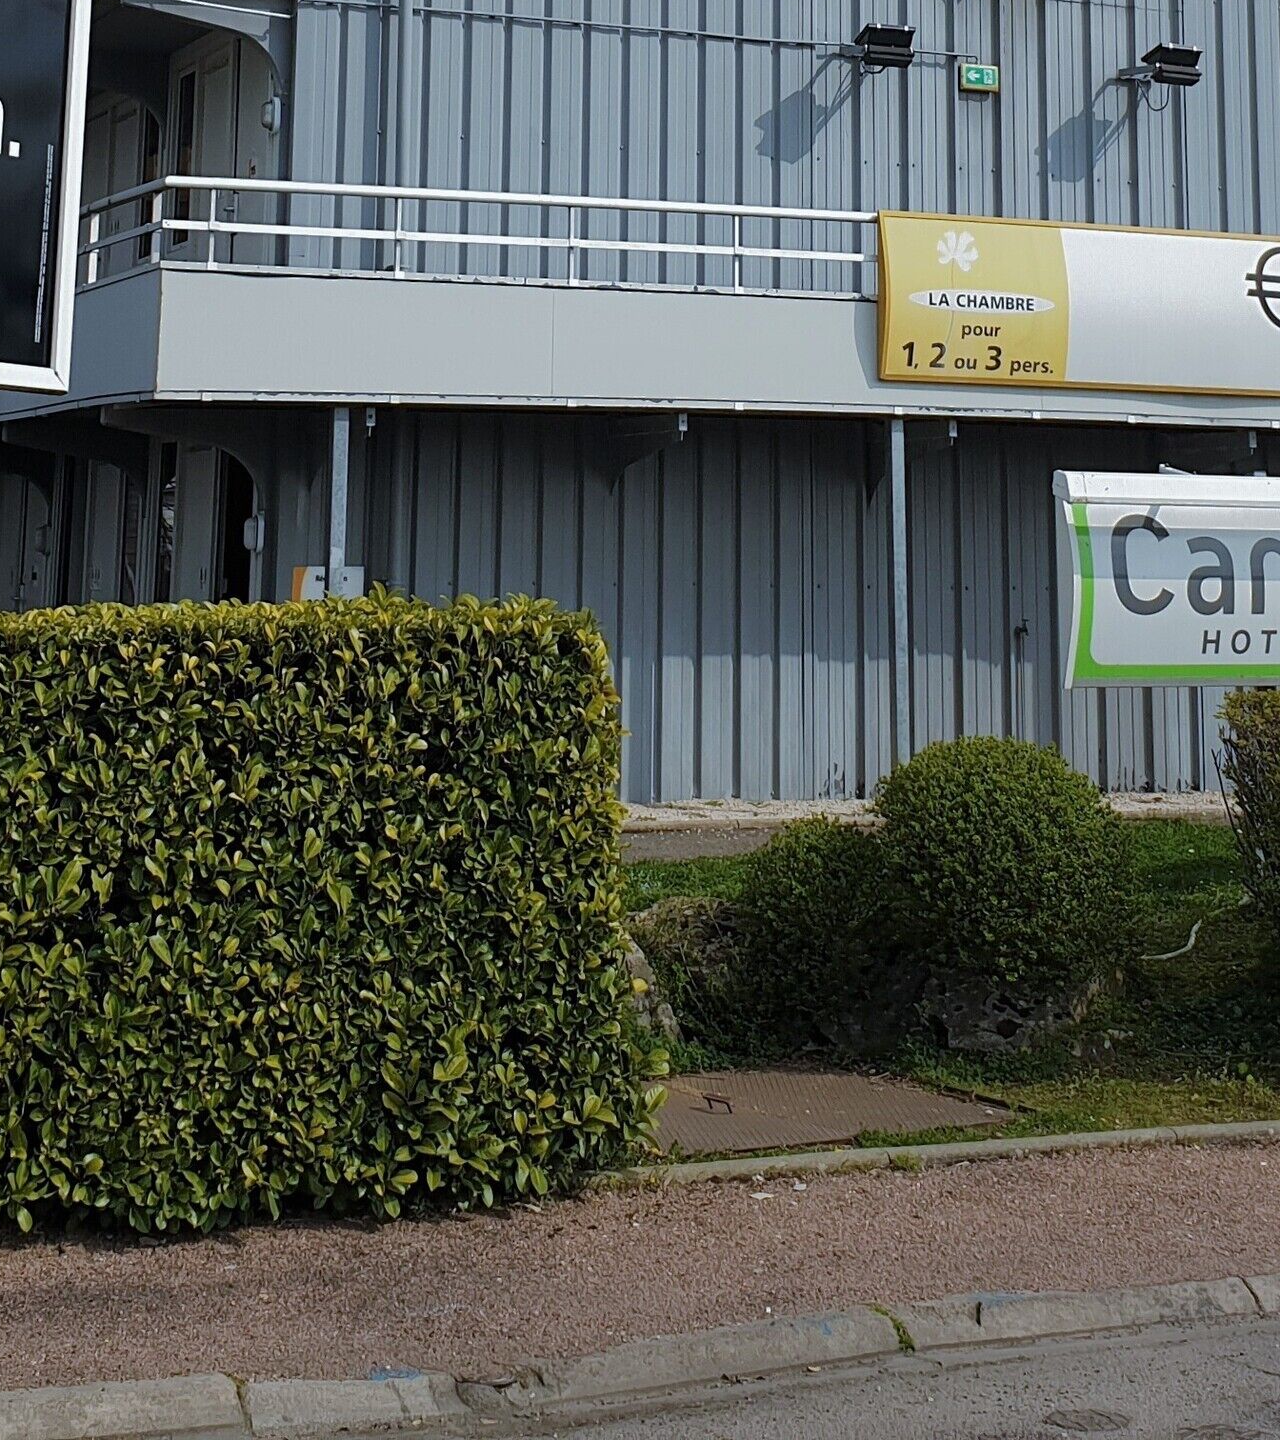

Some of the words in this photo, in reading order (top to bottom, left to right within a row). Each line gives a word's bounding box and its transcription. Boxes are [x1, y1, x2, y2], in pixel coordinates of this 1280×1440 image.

[928, 292, 951, 308] LA
[956, 293, 1035, 311] CHAMBRE
[961, 324, 1001, 339] pour
[902, 342, 919, 370] 1,
[929, 342, 946, 369] 2
[954, 355, 977, 370] ou
[985, 345, 1002, 371] 3
[1010, 357, 1054, 376] pers.
